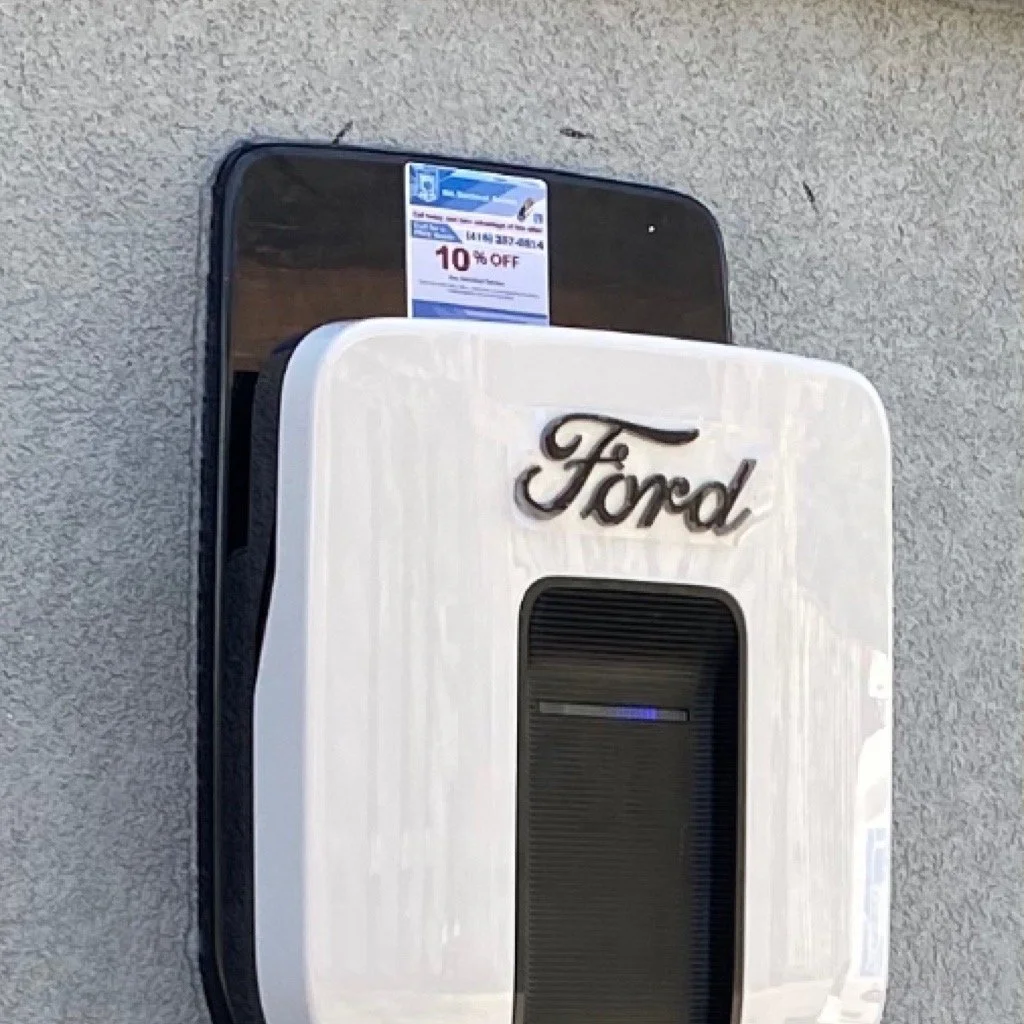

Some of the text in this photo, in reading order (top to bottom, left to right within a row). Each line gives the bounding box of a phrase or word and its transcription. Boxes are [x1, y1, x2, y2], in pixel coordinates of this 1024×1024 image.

[435, 245, 520, 272] 10 % OFF
[514, 412, 757, 536] Ford
